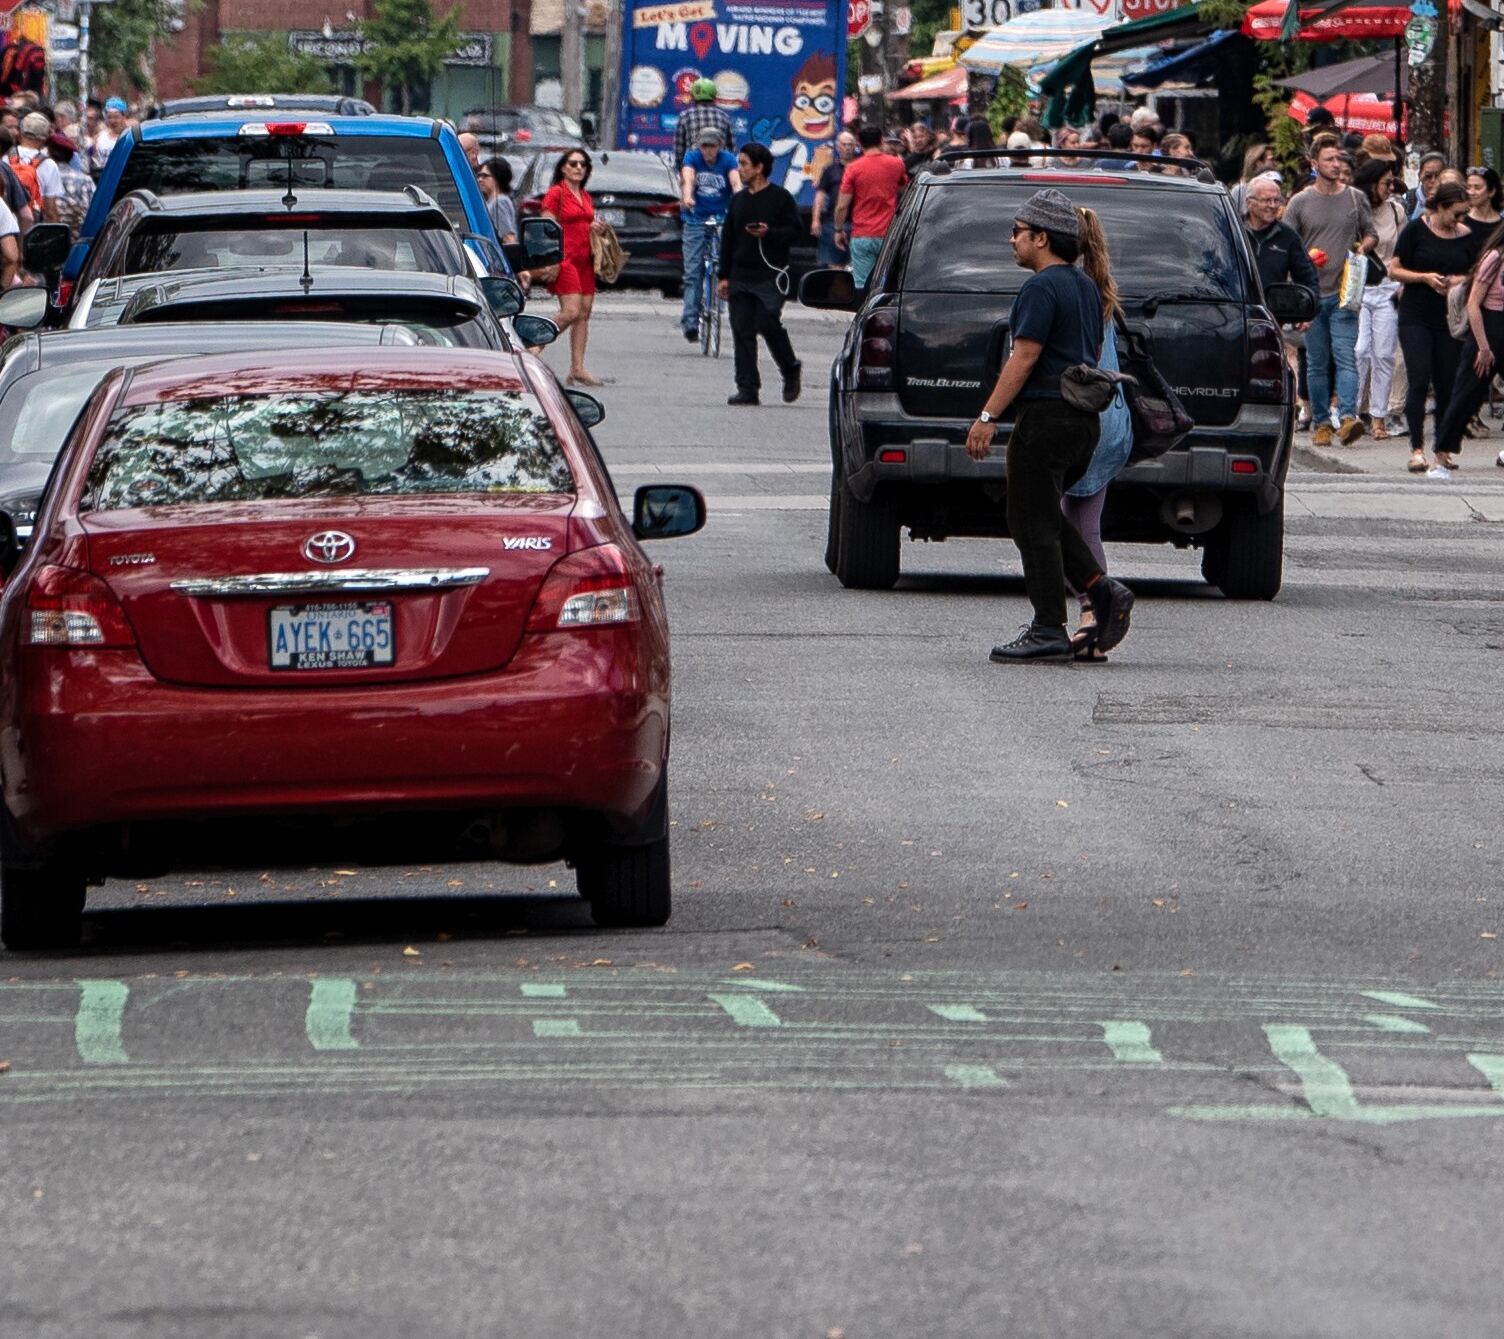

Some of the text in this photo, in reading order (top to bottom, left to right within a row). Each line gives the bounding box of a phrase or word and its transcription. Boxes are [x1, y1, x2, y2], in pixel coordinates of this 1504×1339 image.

[849, 3, 868, 22] OP
[503, 536, 552, 551] YARIS
[108, 553, 156, 565] TOYOTA
[307, 610, 357, 620] ONTARIO
[276, 618, 390, 654] AYEK 665
[298, 650, 366, 664] KEN SHAW
[298, 660, 369, 669] LEXUS TOYOTA
